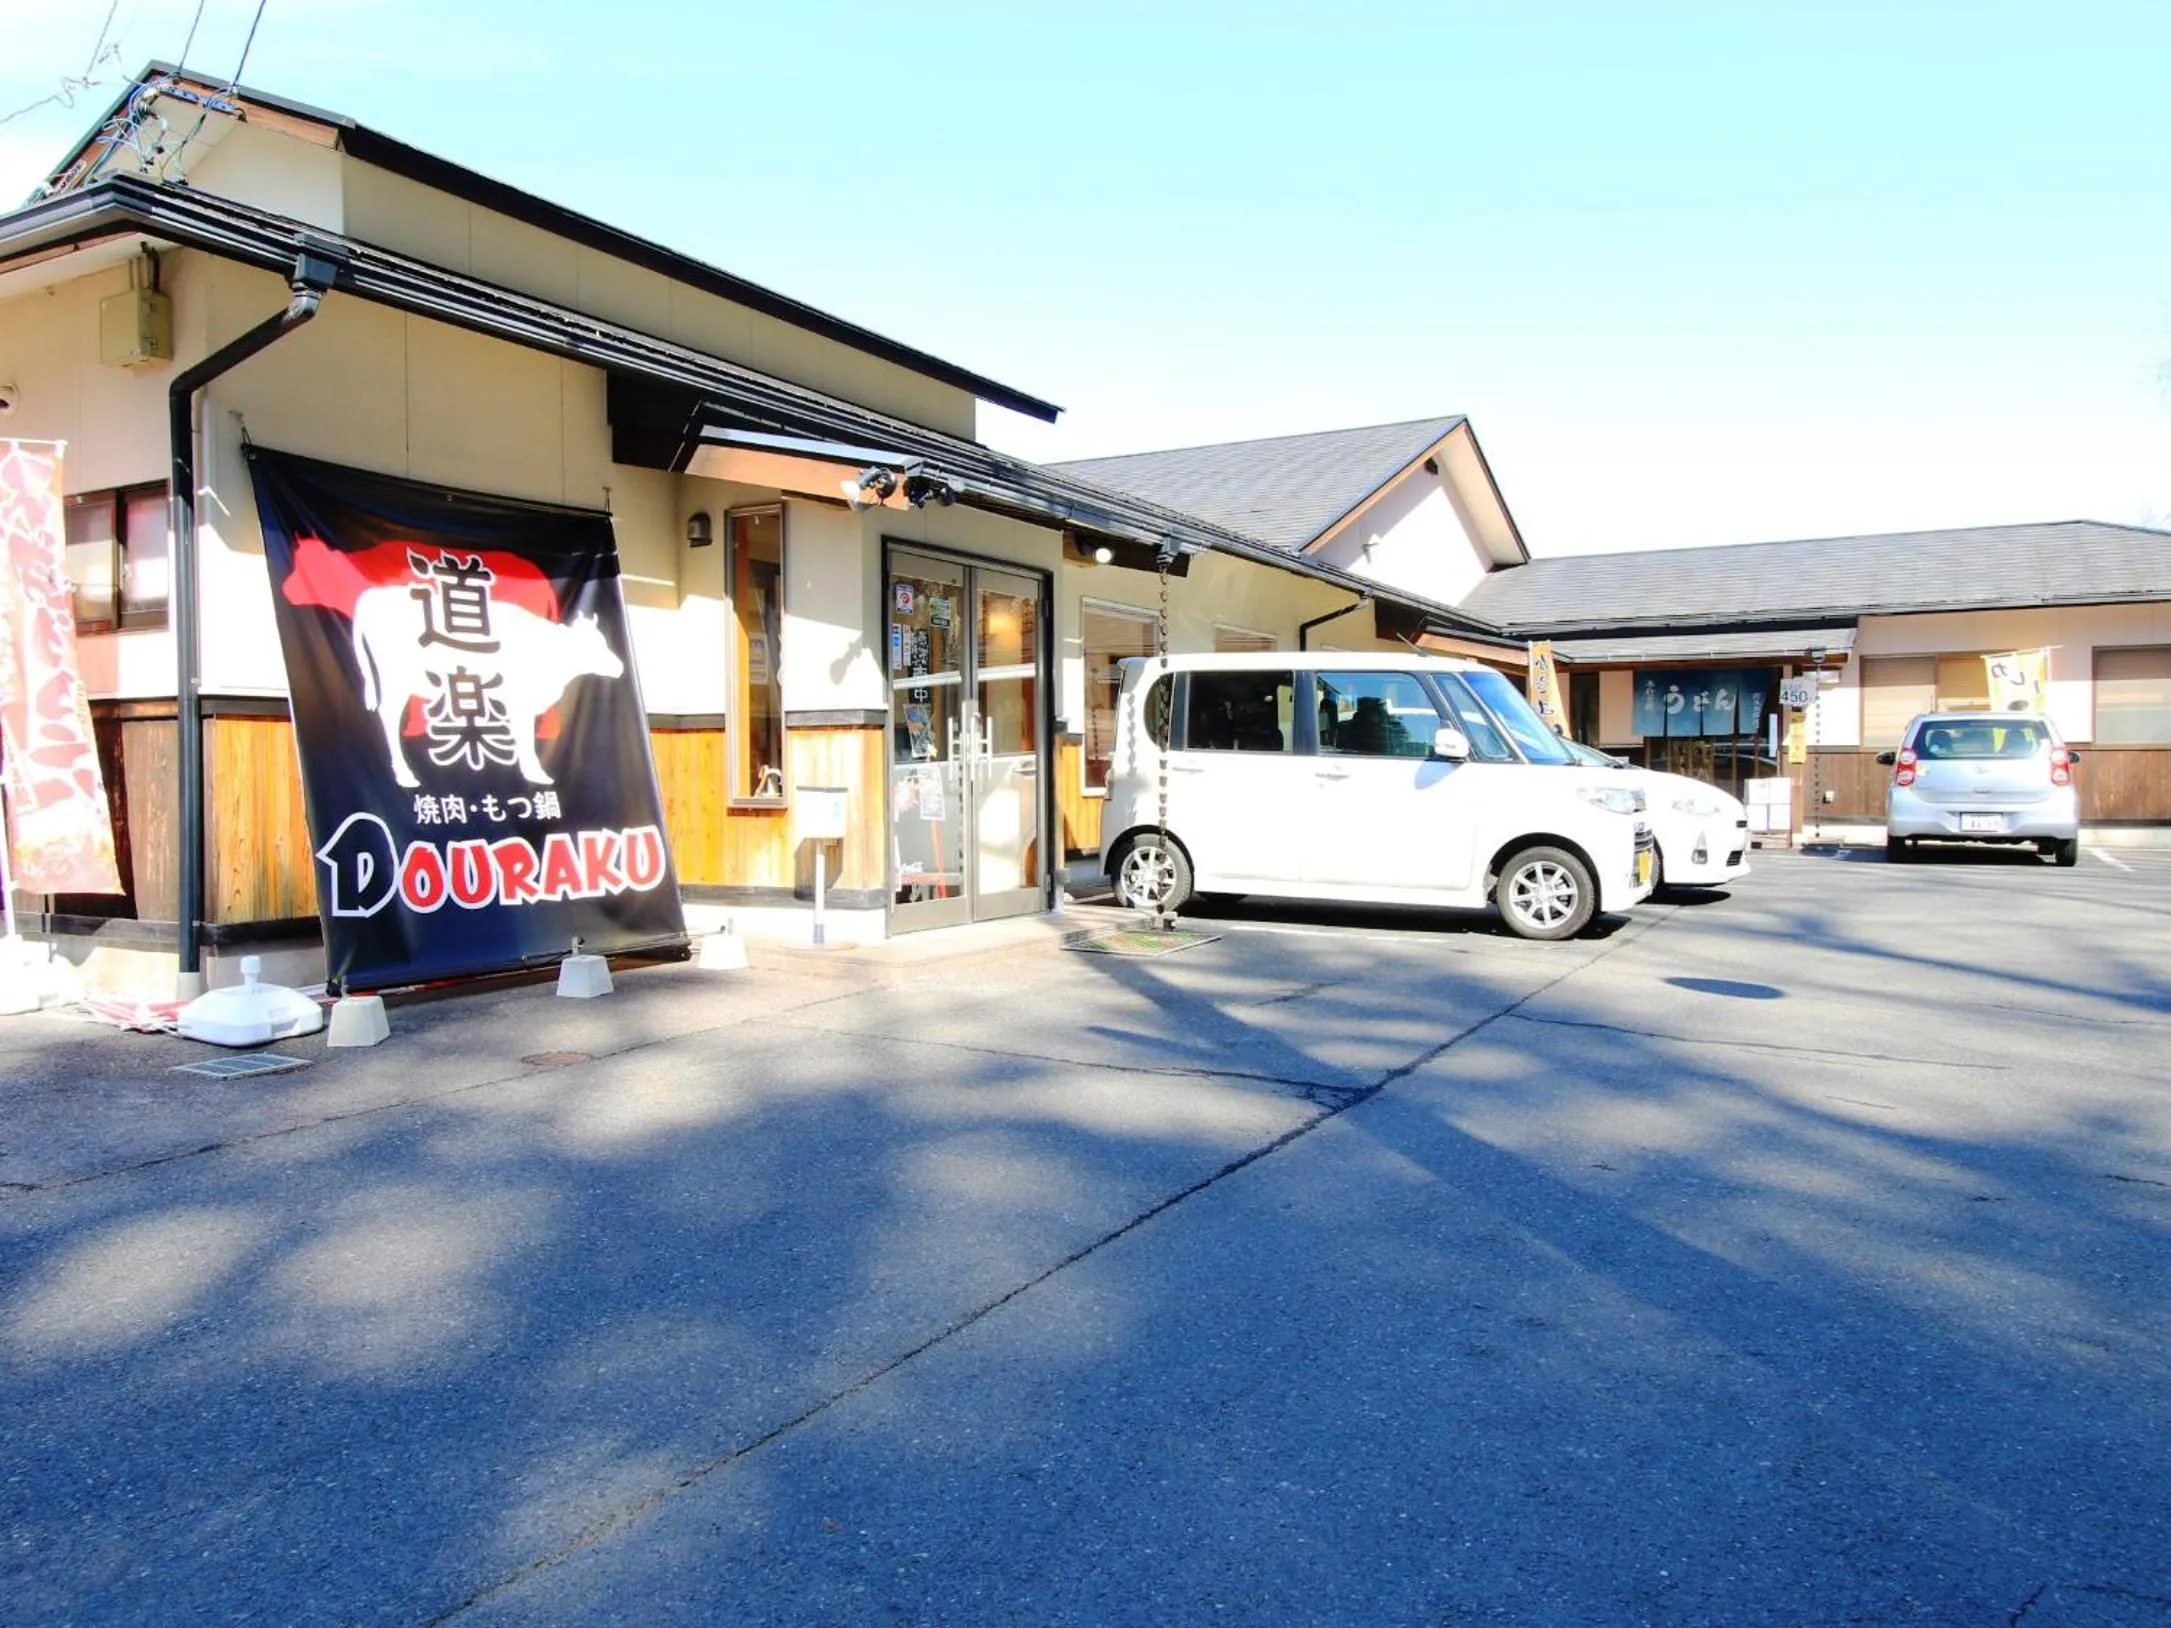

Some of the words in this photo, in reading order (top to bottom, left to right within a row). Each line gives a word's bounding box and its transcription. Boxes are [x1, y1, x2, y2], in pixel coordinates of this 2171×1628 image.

[406, 548, 518, 769] 道楽
[1663, 684, 1736, 715] うどん
[1779, 689, 1808, 703] 450
[317, 812, 667, 917] DOURAKU
